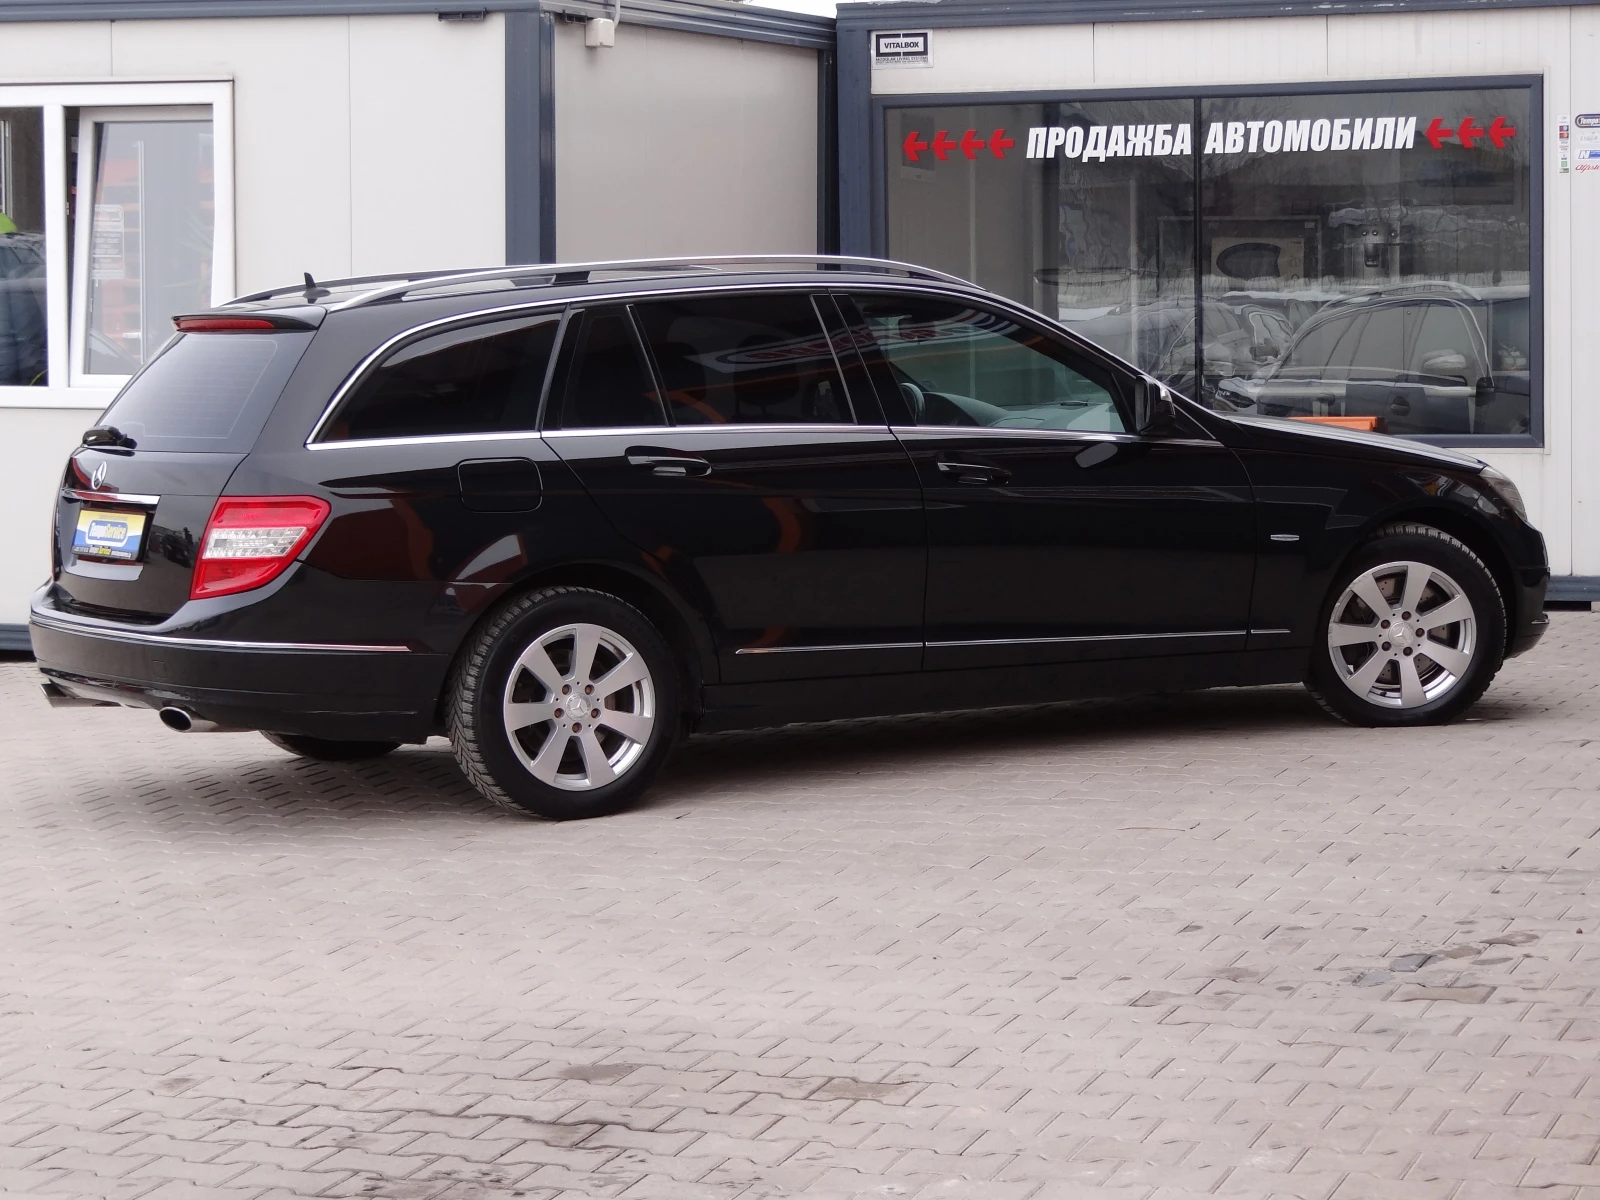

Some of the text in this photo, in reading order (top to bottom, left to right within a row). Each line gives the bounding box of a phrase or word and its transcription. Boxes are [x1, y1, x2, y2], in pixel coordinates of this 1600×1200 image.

[1580, 117, 1600, 126] Tempo
[1026, 116, 1417, 162] ПРОДАЖБА АВТОМОБИЛИ
